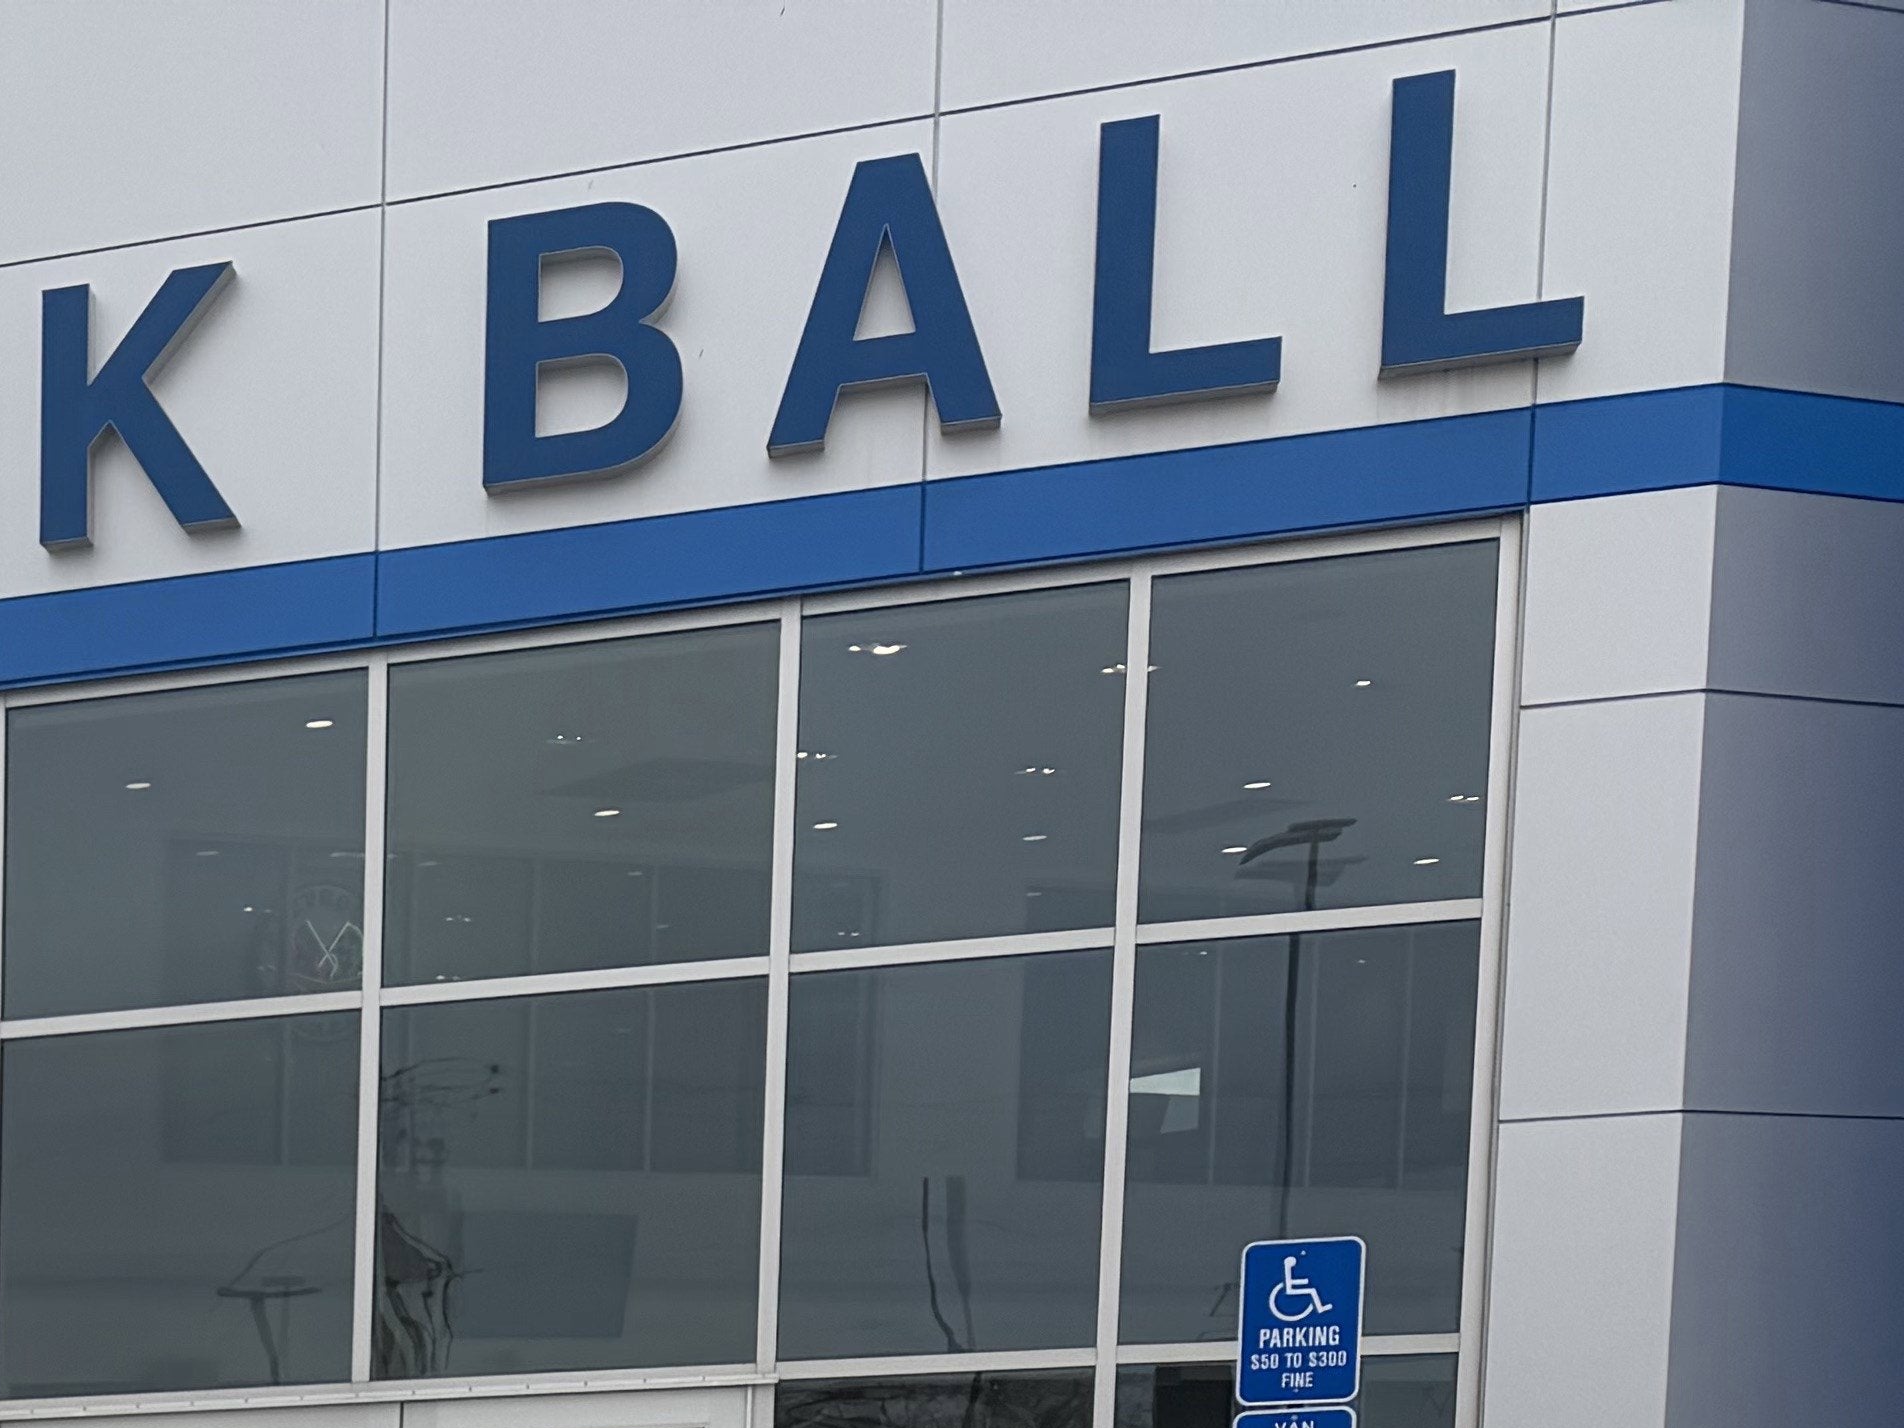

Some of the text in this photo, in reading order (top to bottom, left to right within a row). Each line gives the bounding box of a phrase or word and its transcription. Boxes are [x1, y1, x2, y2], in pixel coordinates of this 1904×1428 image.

[482, 70, 1584, 495] BALL
[1259, 1326, 1340, 1349] PARKING
[1250, 1350, 1347, 1370] $50 TO $300
[1281, 1372, 1314, 1389] FINE
